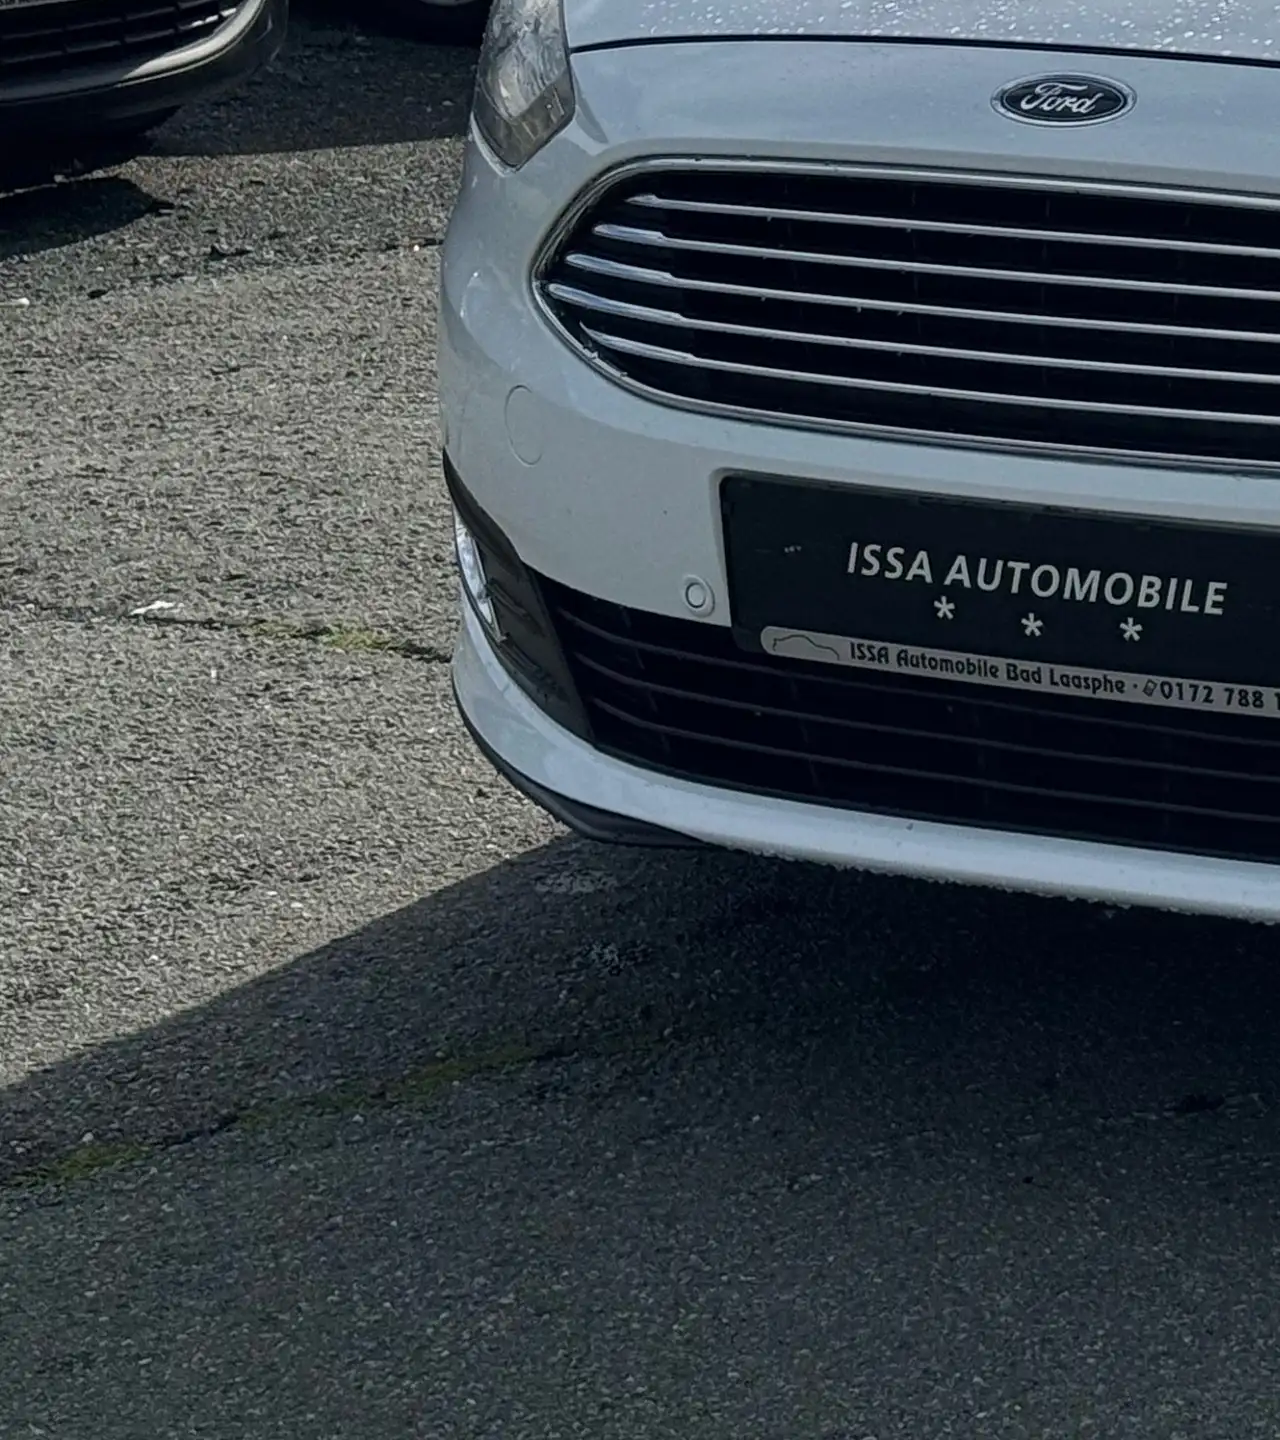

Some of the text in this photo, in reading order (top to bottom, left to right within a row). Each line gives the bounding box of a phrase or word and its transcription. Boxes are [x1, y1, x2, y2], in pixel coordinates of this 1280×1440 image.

[1020, 81, 1104, 114] Ford
[846, 541, 1229, 616] ISSA AUTOMOBILE
[850, 641, 890, 665] ISSA
[896, 648, 999, 679] Automobile
[1005, 662, 1042, 685] Bad
[1049, 668, 1126, 695] Laasphe
[1160, 680, 1215, 704] 0172
[1223, 687, 1265, 709] 788
